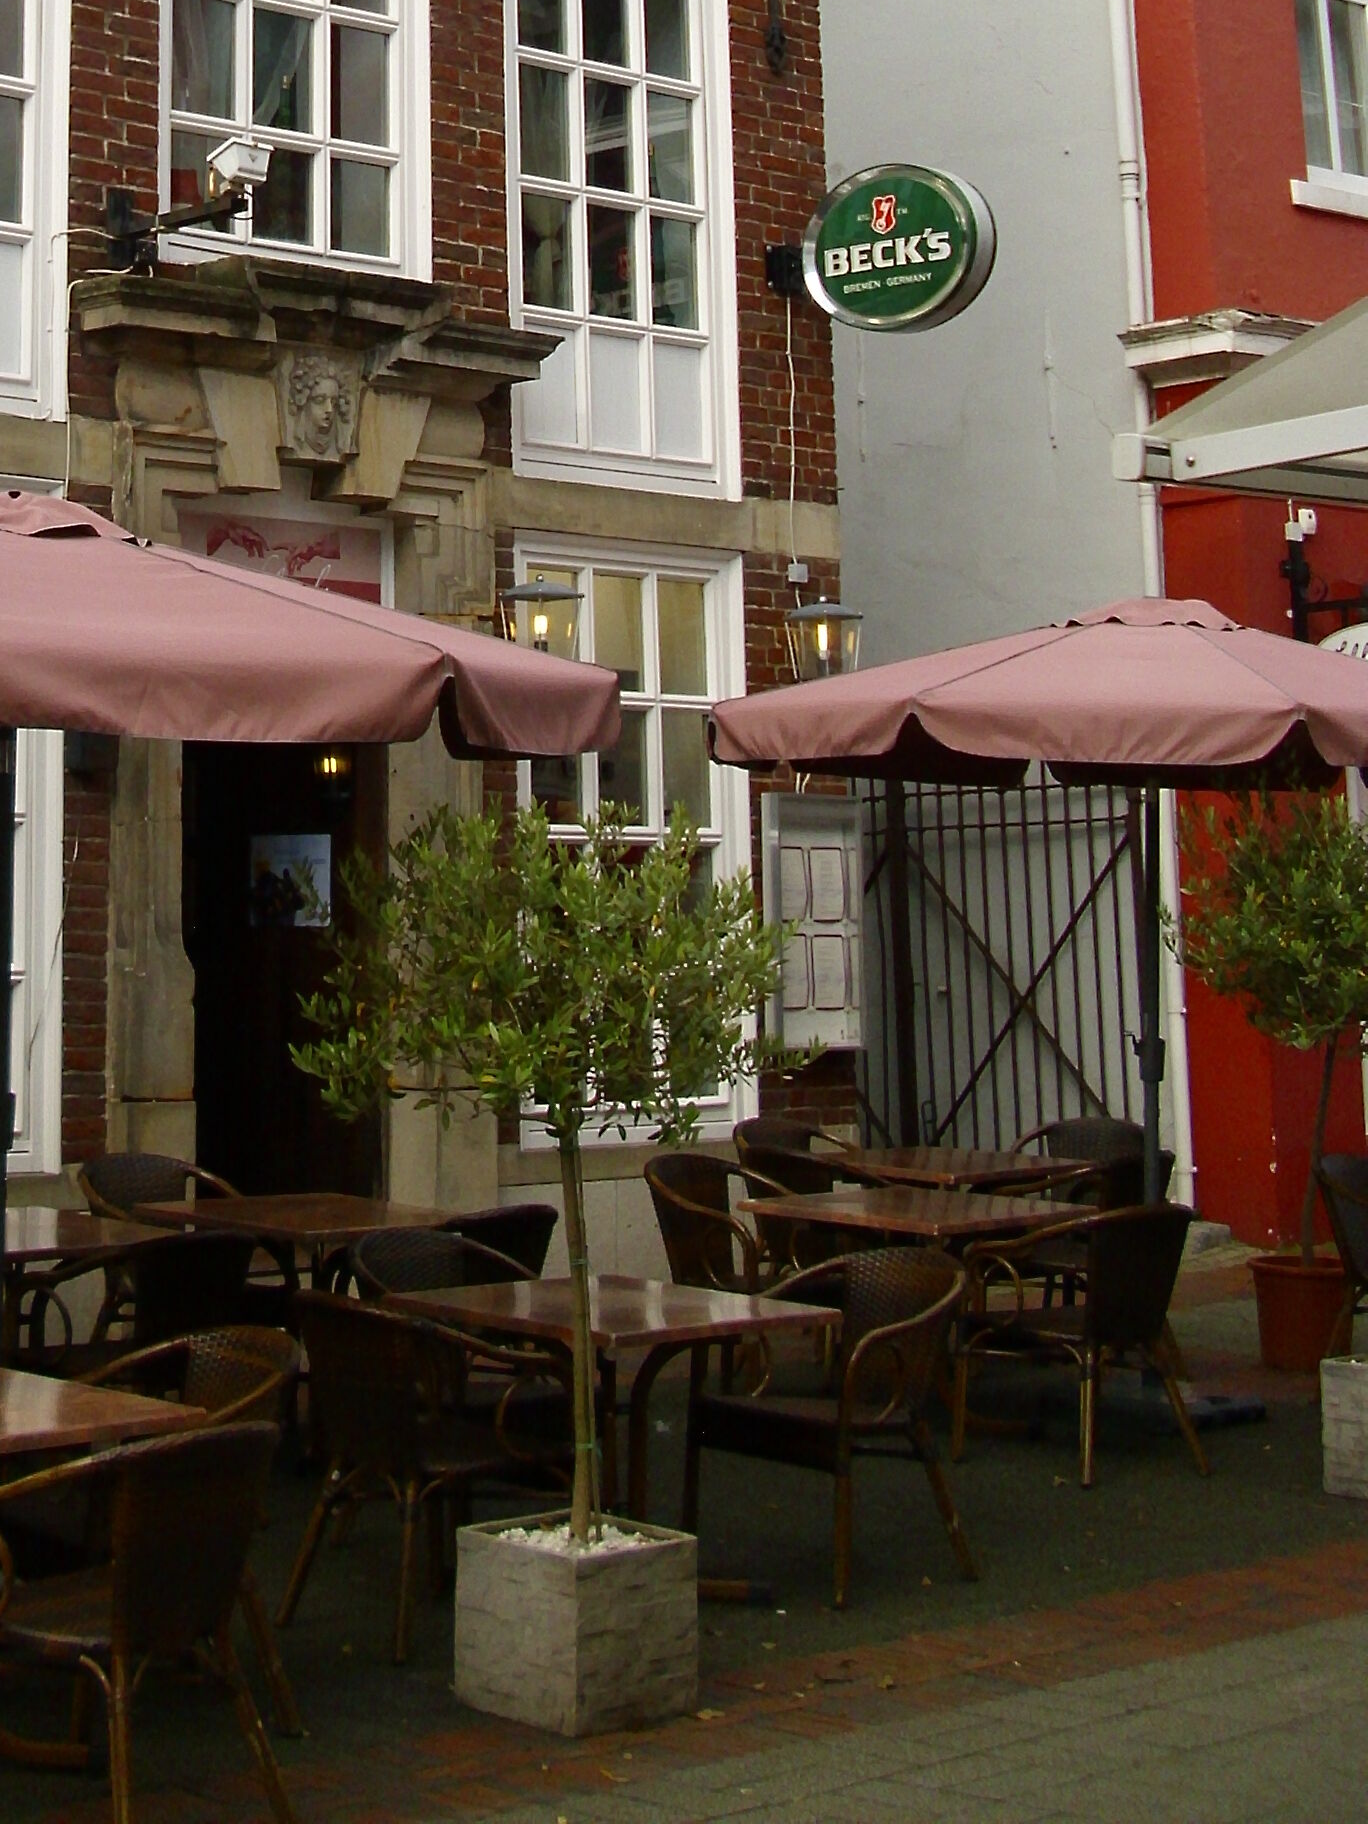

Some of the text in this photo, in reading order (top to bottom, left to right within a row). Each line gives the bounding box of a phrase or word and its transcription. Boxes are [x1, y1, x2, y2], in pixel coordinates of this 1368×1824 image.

[824, 228, 952, 277] BECK'S
[843, 272, 932, 293] BREMEN GERMANY
